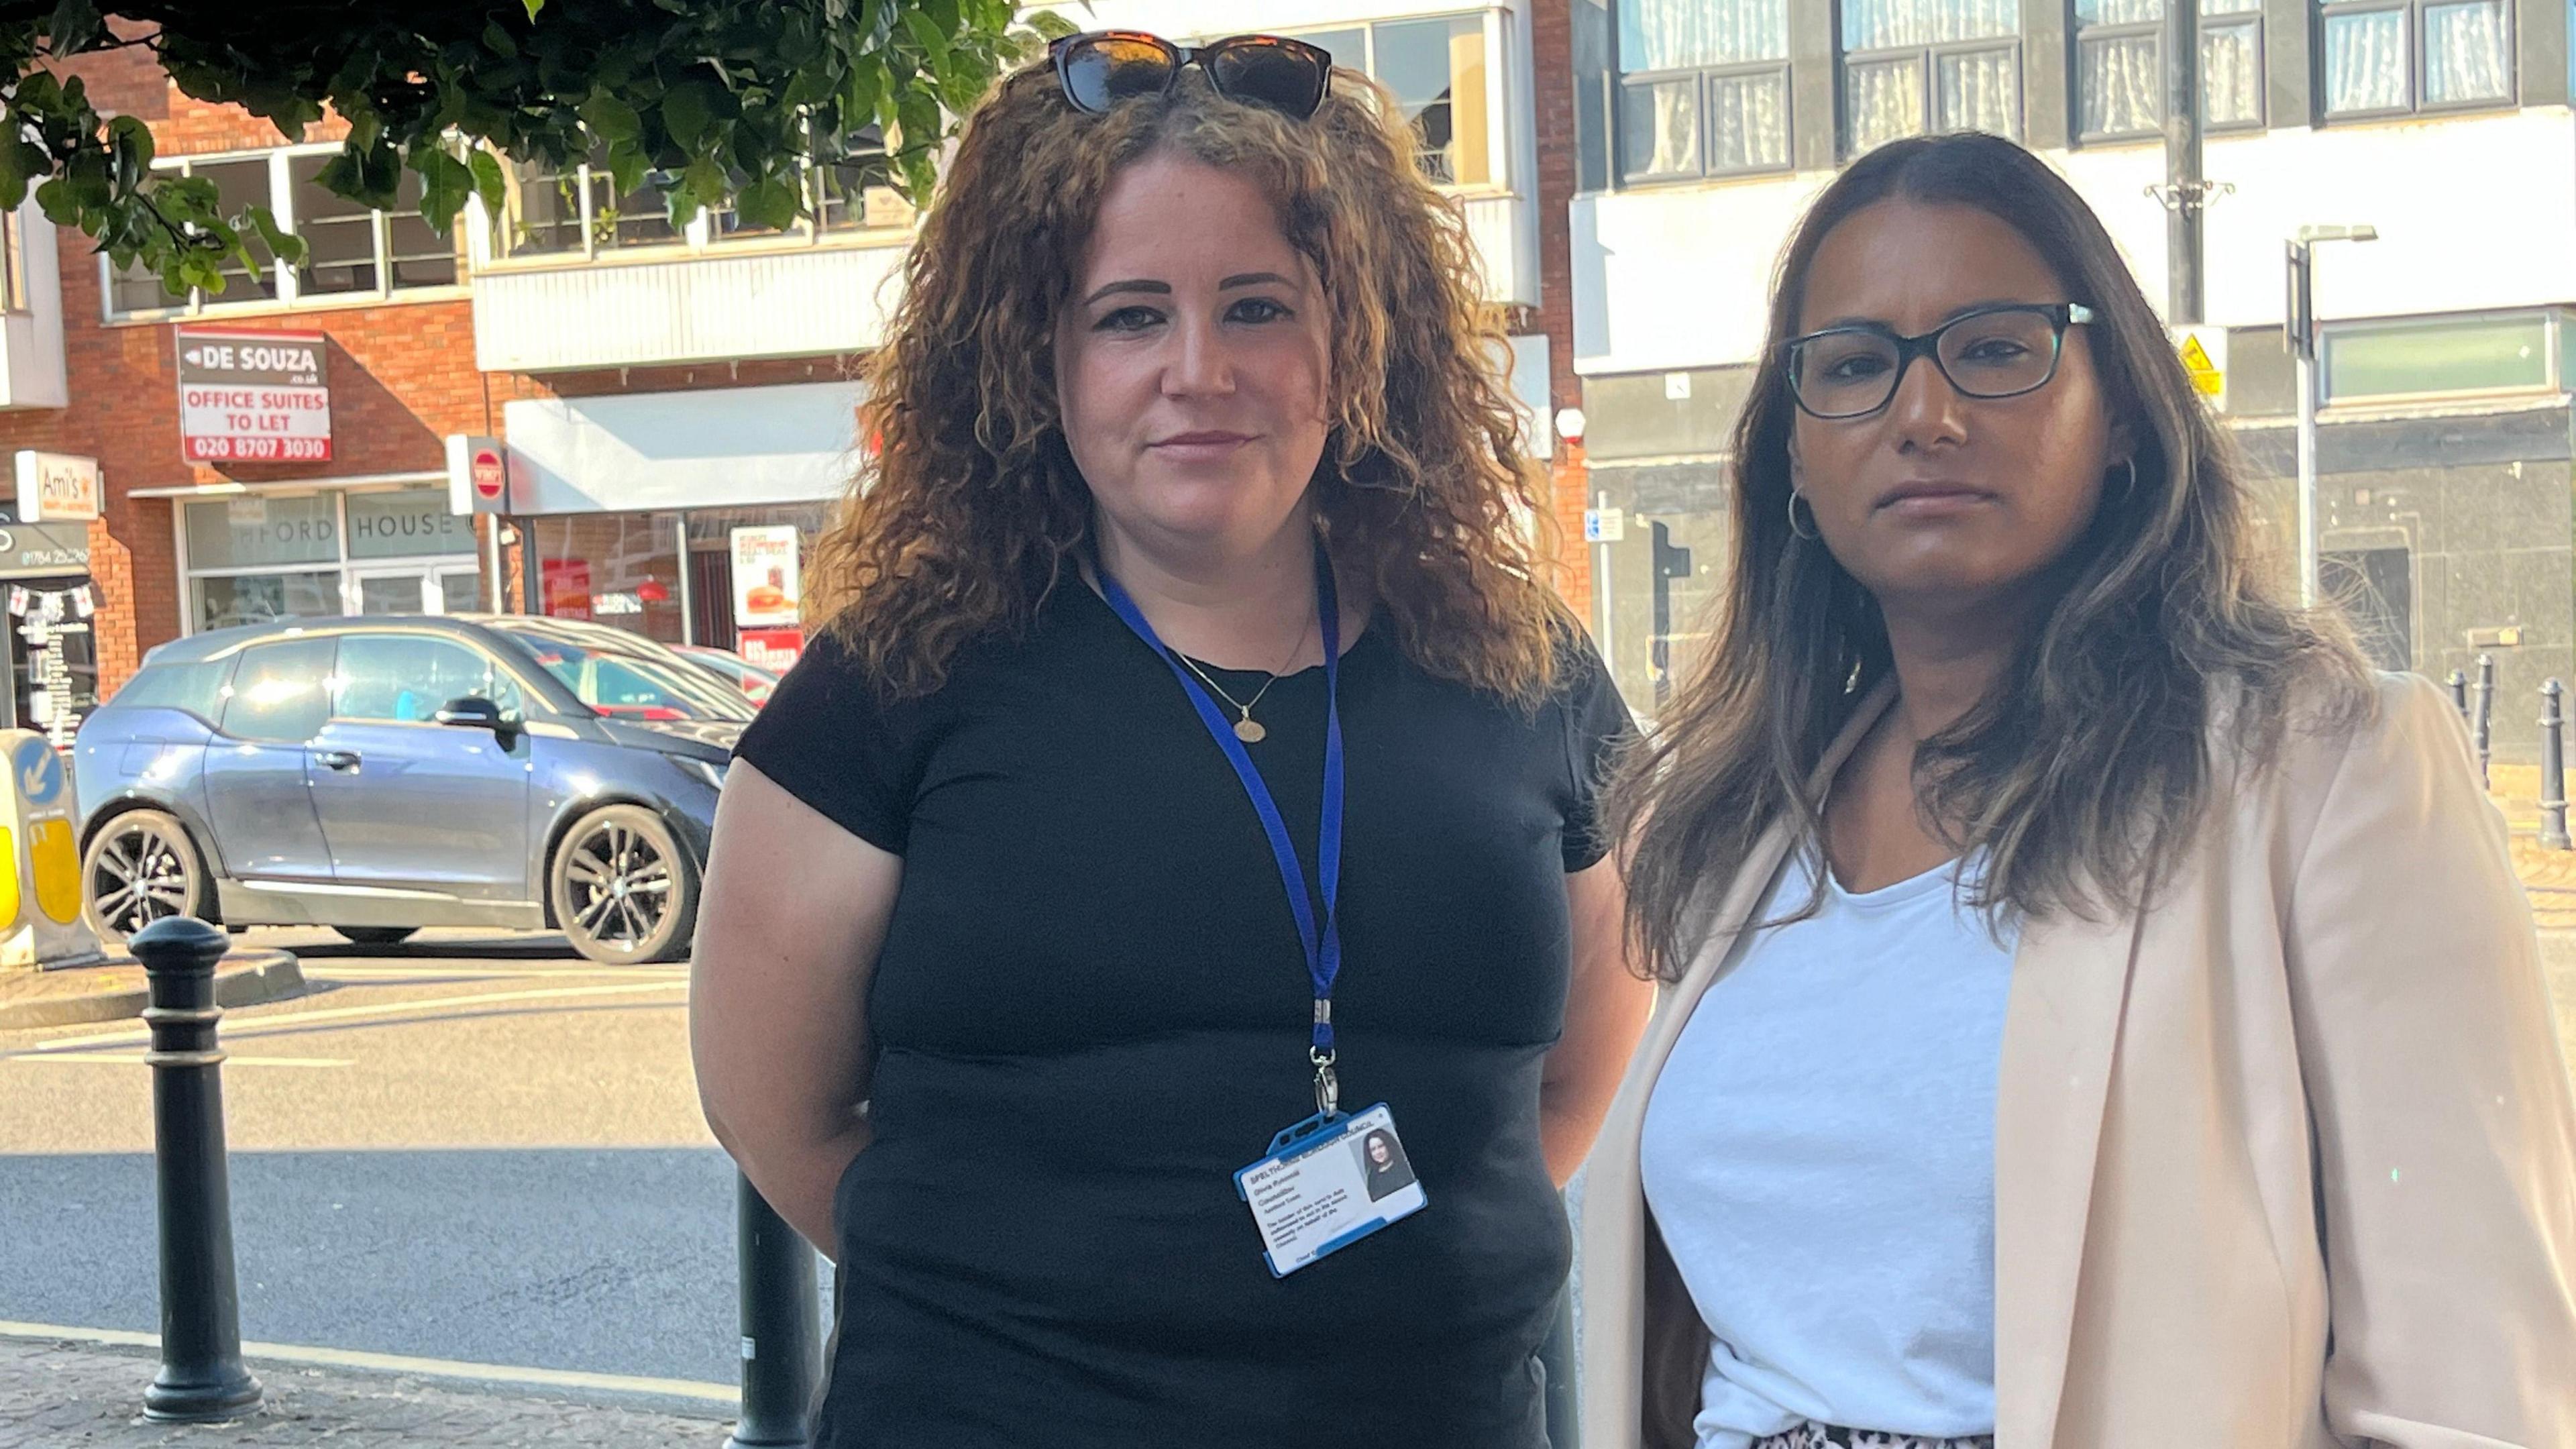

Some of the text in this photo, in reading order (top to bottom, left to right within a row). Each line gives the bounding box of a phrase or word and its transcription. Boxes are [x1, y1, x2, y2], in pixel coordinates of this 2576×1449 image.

[203, 345, 317, 372] DE SOUZA
[188, 391, 324, 410] OFFICE SUITES
[227, 414, 290, 431] TO LET
[195, 438, 325, 458] 020 8707 3030
[43, 467, 78, 499] Ami's
[358, 513, 453, 537] HOUSE
